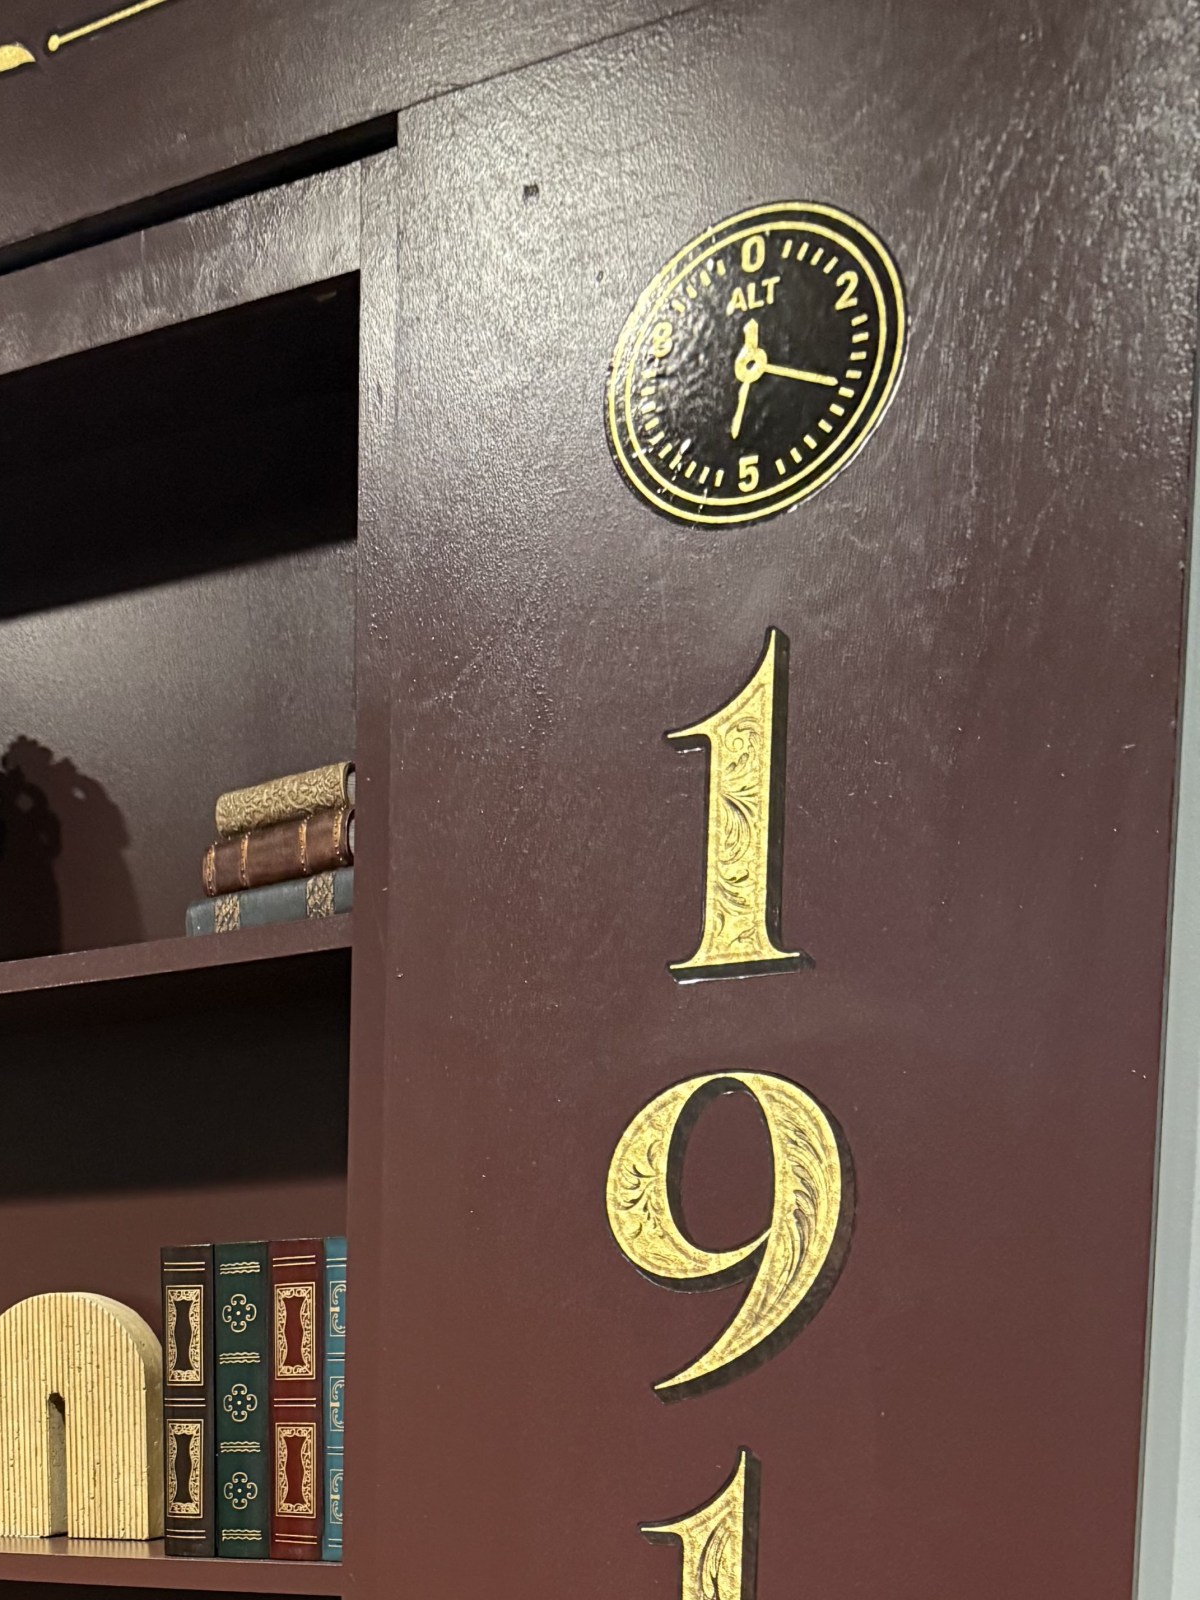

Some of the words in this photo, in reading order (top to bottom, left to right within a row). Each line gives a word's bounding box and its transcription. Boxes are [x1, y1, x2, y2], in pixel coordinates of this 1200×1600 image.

[740, 234, 767, 273] 0
[726, 276, 781, 316] ALT
[835, 269, 860, 312] 2
[651, 321, 674, 358] 8
[737, 455, 760, 492] 5
